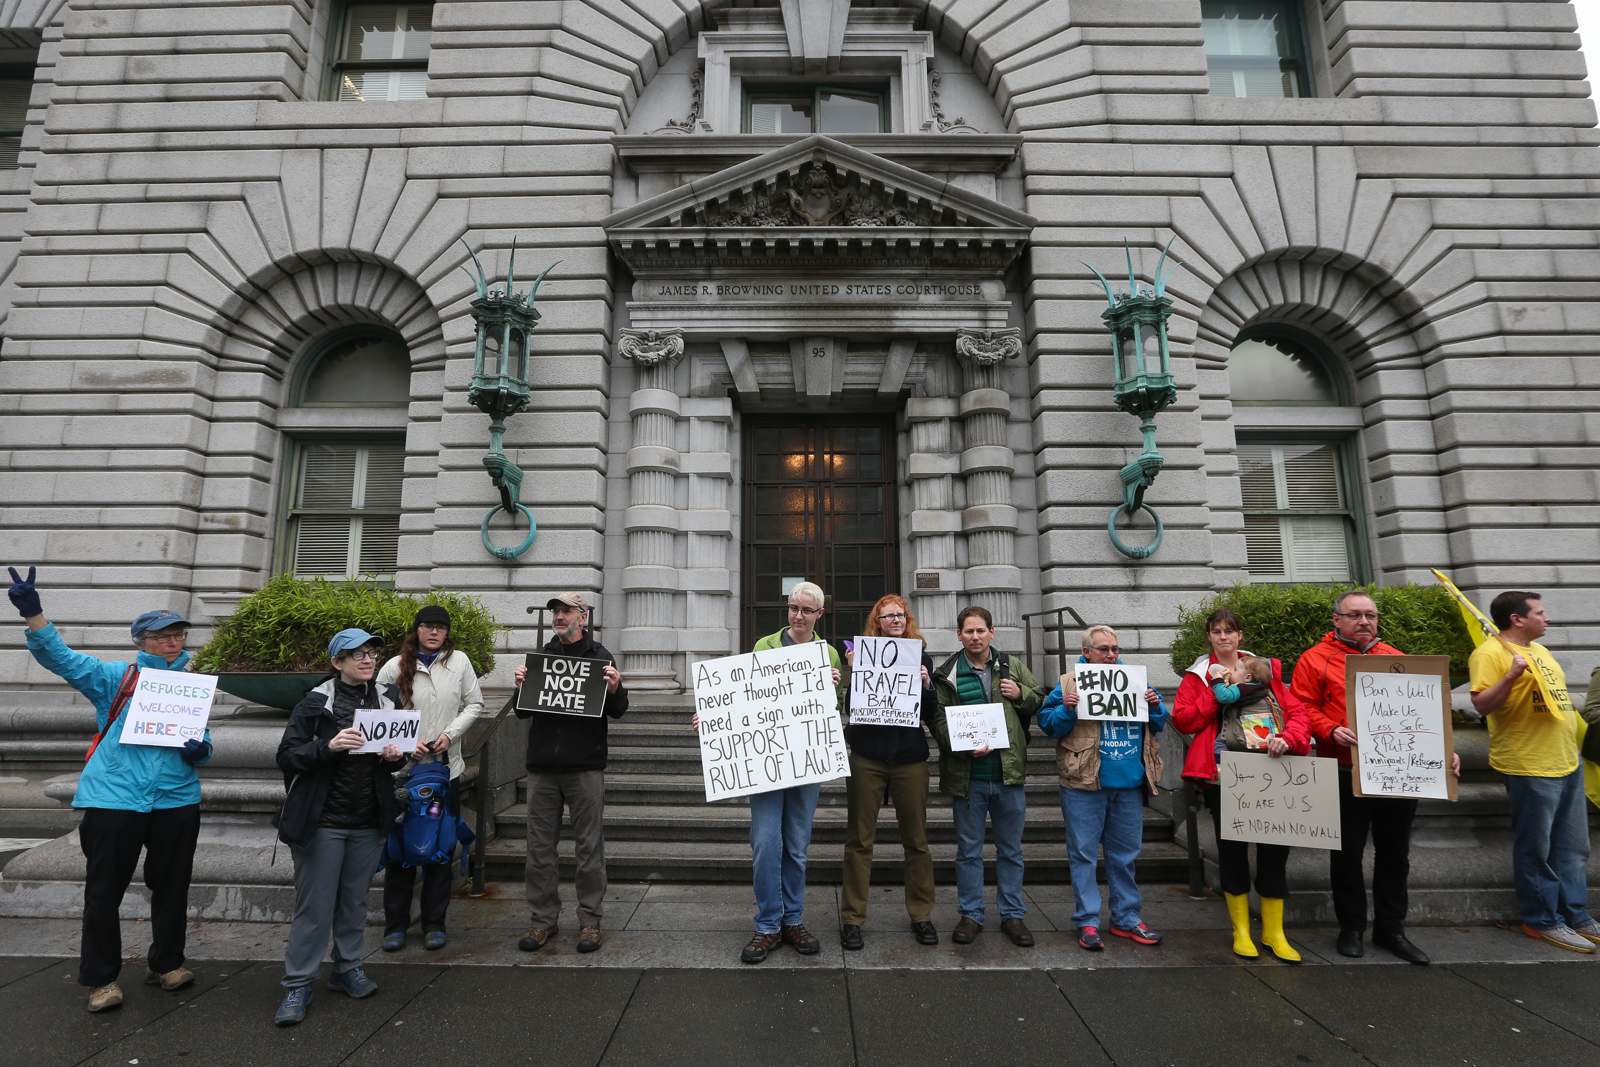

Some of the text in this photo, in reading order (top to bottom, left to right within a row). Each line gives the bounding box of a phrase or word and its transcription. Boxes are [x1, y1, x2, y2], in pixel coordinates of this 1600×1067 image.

[658, 284, 981, 296] JAMES R. BROWNING UNITED STATES COURTHOUSE
[812, 347, 826, 359] 95
[859, 638, 899, 669] NO
[542, 658, 591, 677] LOVE
[697, 641, 831, 689] As an American, I
[140, 680, 211, 699] REFUGEES
[544, 674, 586, 693] NOT
[852, 670, 918, 697] TRAVEL
[1077, 669, 1129, 692] #NO
[1361, 674, 1390, 698] Ban
[1407, 680, 1435, 701] Wall
[538, 690, 586, 710] HATE
[697, 671, 825, 711] never thought I'd
[867, 693, 897, 708] BAN
[139, 702, 204, 717] WELCOME
[1087, 692, 1137, 718] BAN
[1371, 701, 1401, 718] Make
[701, 698, 825, 736] need a sign with
[1367, 718, 1428, 732] Less Safe
[134, 720, 178, 737] HERE
[359, 719, 420, 742] NO BAN
[801, 715, 840, 746] THE
[709, 758, 759, 794] RULE
[764, 753, 785, 783] OF
[1255, 799, 1275, 808] ARE
